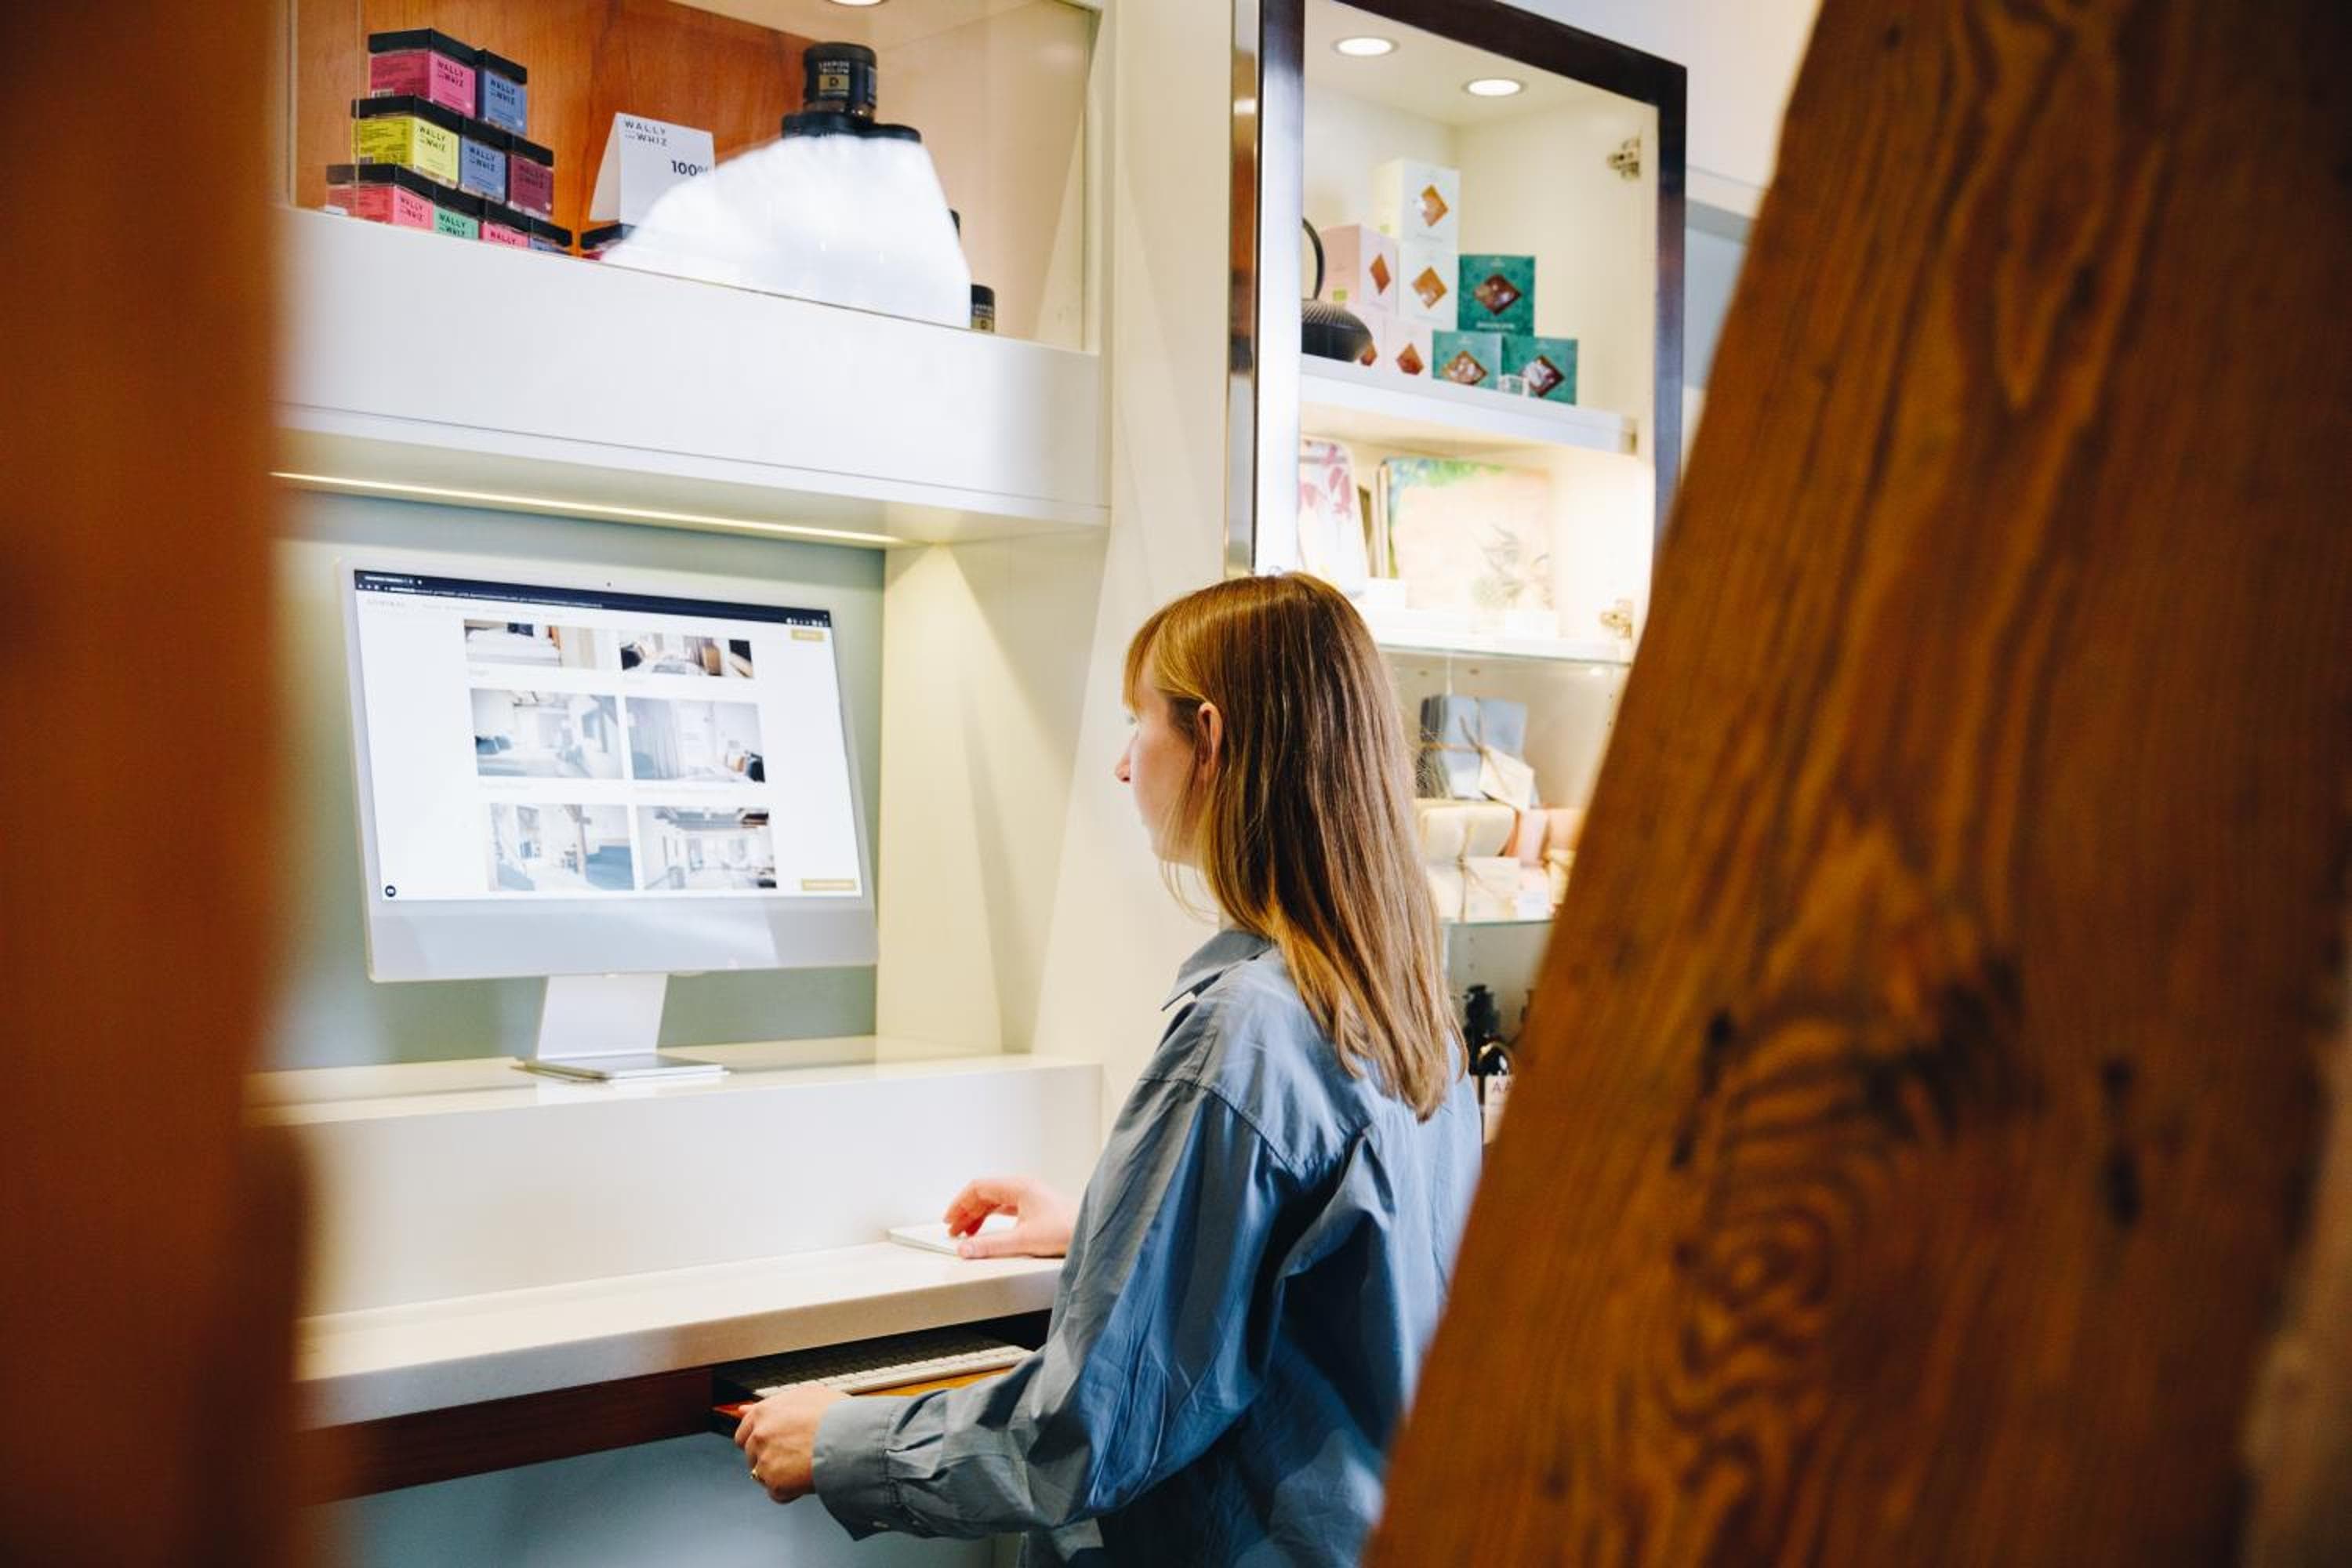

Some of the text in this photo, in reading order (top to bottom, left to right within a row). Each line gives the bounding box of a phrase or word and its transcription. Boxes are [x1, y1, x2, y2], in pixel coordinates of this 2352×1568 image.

[437, 60, 464, 78] WALLY
[490, 78, 515, 95] WALLY
[419, 125, 446, 141] WALLY
[625, 120, 666, 135] WALLY
[637, 132, 666, 147] WHIZ
[469, 144, 495, 162] WALLY
[401, 196, 423, 210] WALLY
[438, 212, 466, 228] WALLY
[490, 230, 516, 245] WALLY
